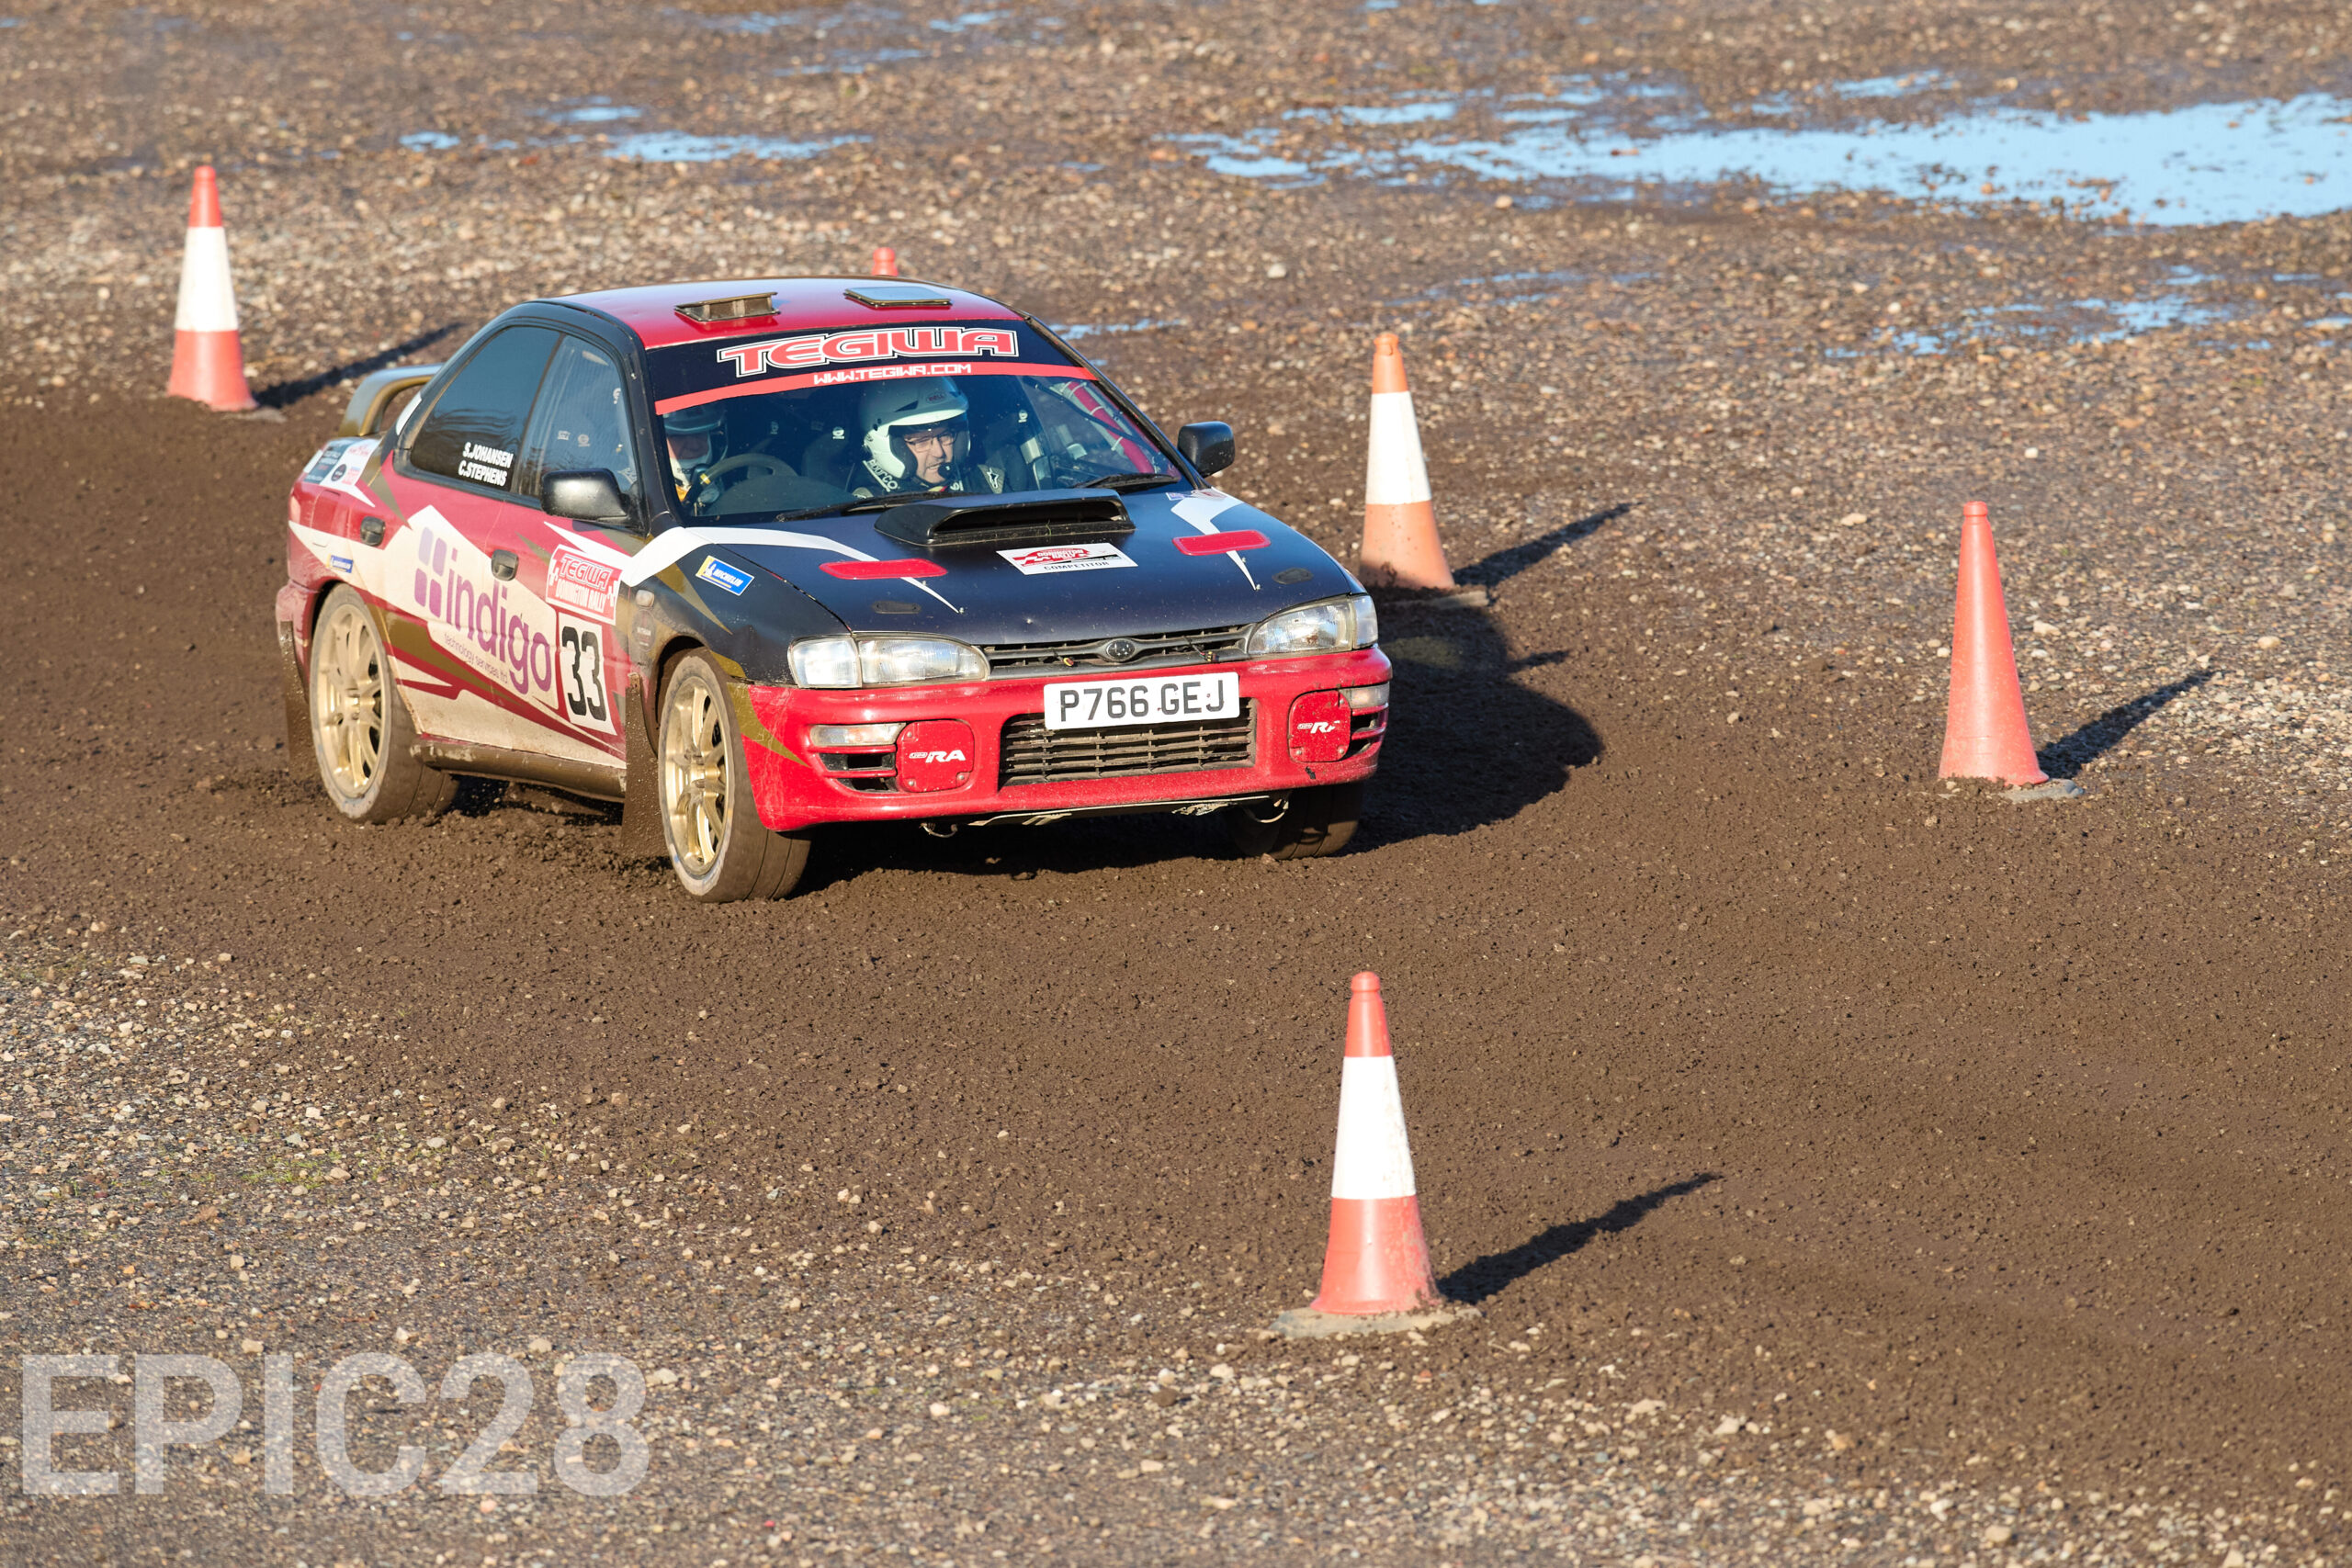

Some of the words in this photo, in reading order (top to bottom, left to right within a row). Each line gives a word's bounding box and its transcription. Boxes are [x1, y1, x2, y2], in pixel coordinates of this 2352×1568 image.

[717, 327, 1019, 378] TEGIWA
[814, 364, 971, 385] WWW.TEGIWA.COM
[462, 442, 514, 468] S.JOHANSEN
[458, 459, 508, 487] C.STEPHENS
[560, 553, 613, 592] TEGIWA
[1044, 561, 1110, 570] COMPETITOR
[446, 547, 552, 694] indigo
[561, 626, 607, 722] 33
[1059, 685, 1148, 722] P766
[1160, 680, 1225, 716] GEJ
[925, 750, 966, 763] RA
